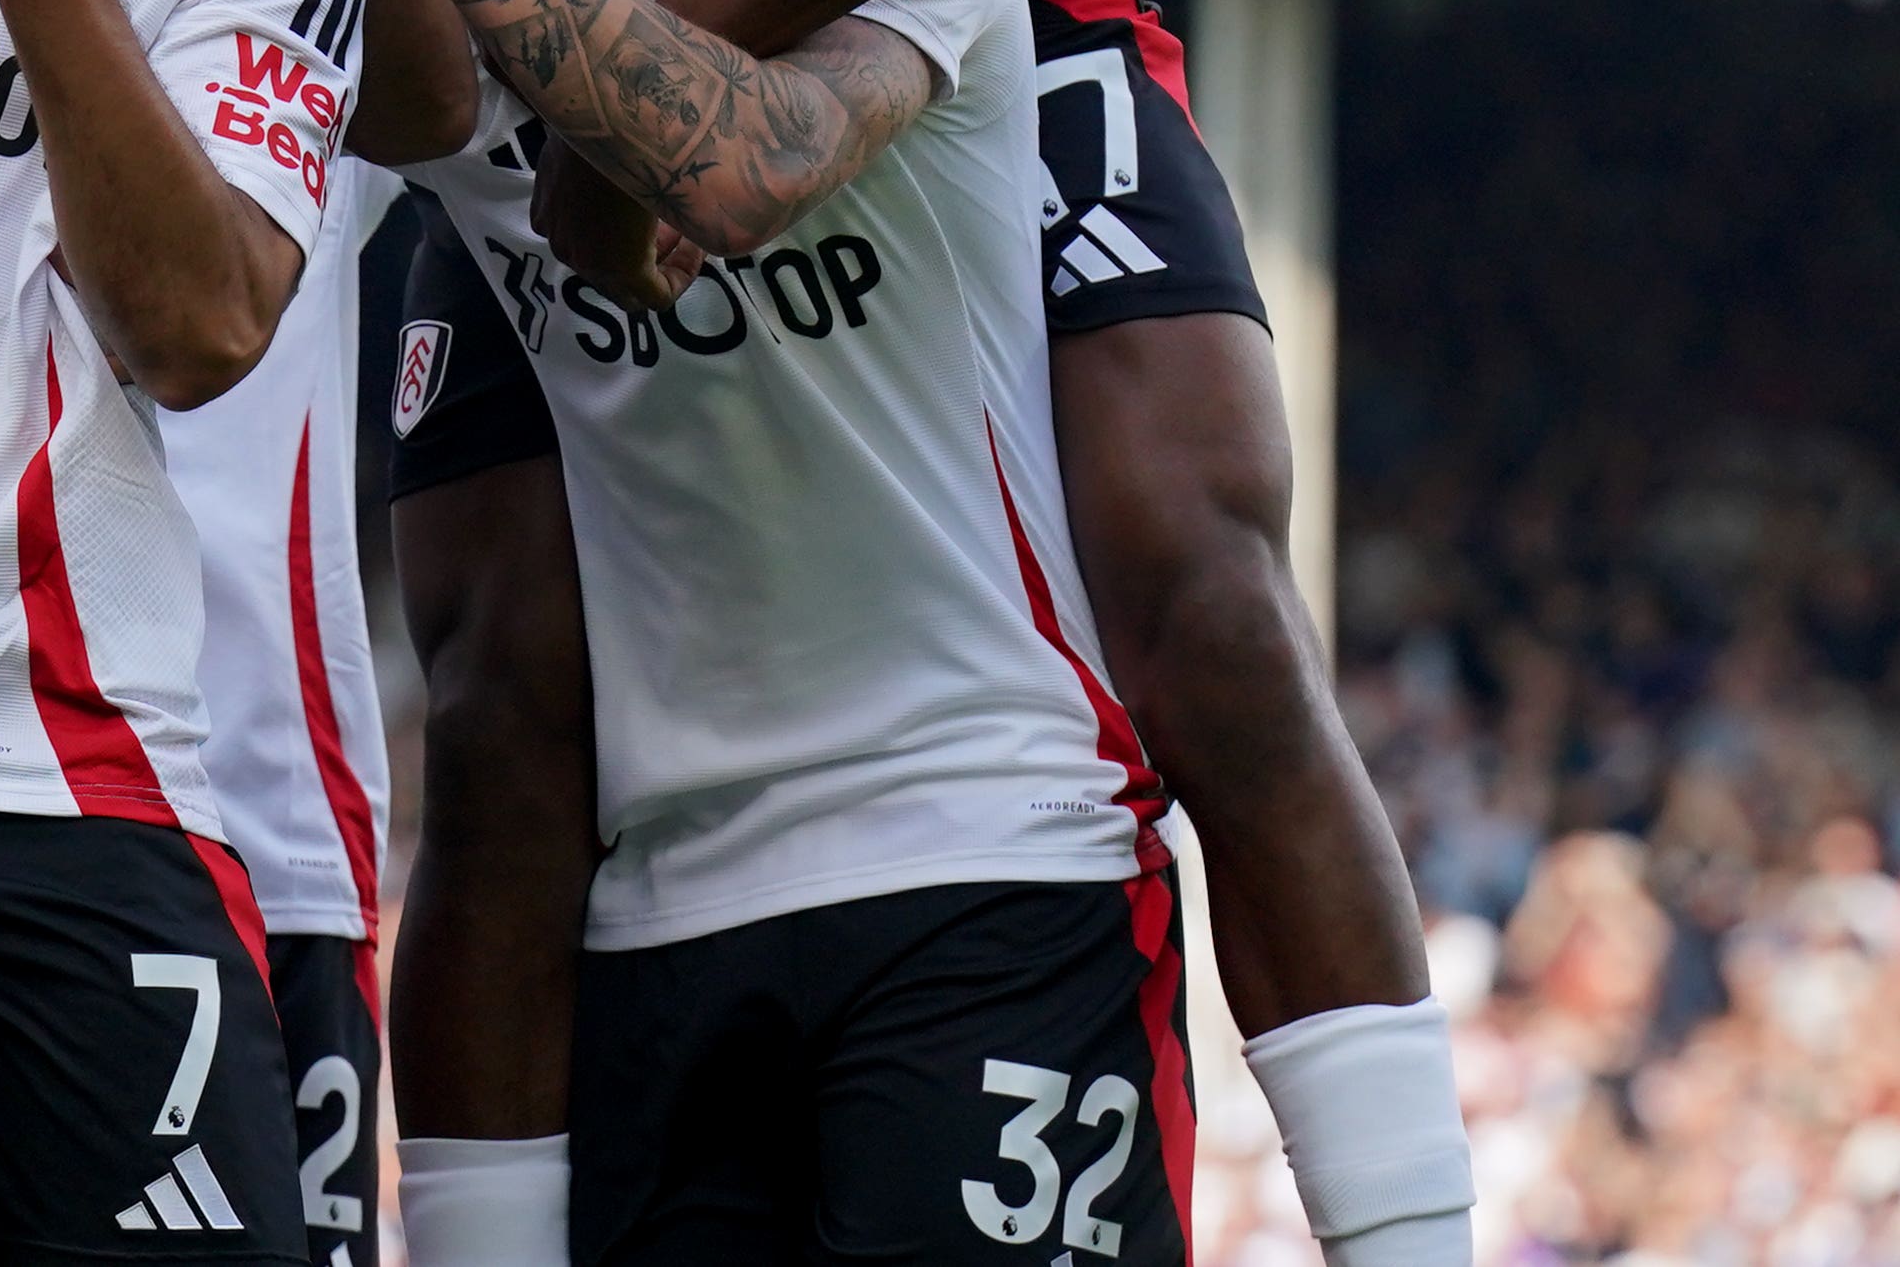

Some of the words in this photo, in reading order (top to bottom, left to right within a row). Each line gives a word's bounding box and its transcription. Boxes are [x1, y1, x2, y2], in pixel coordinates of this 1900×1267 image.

[205, 82, 327, 211] Bed
[235, 31, 348, 161] Web
[401, 336, 431, 414] FFC
[130, 953, 222, 1136] 7
[960, 1058, 1140, 1259] 32
